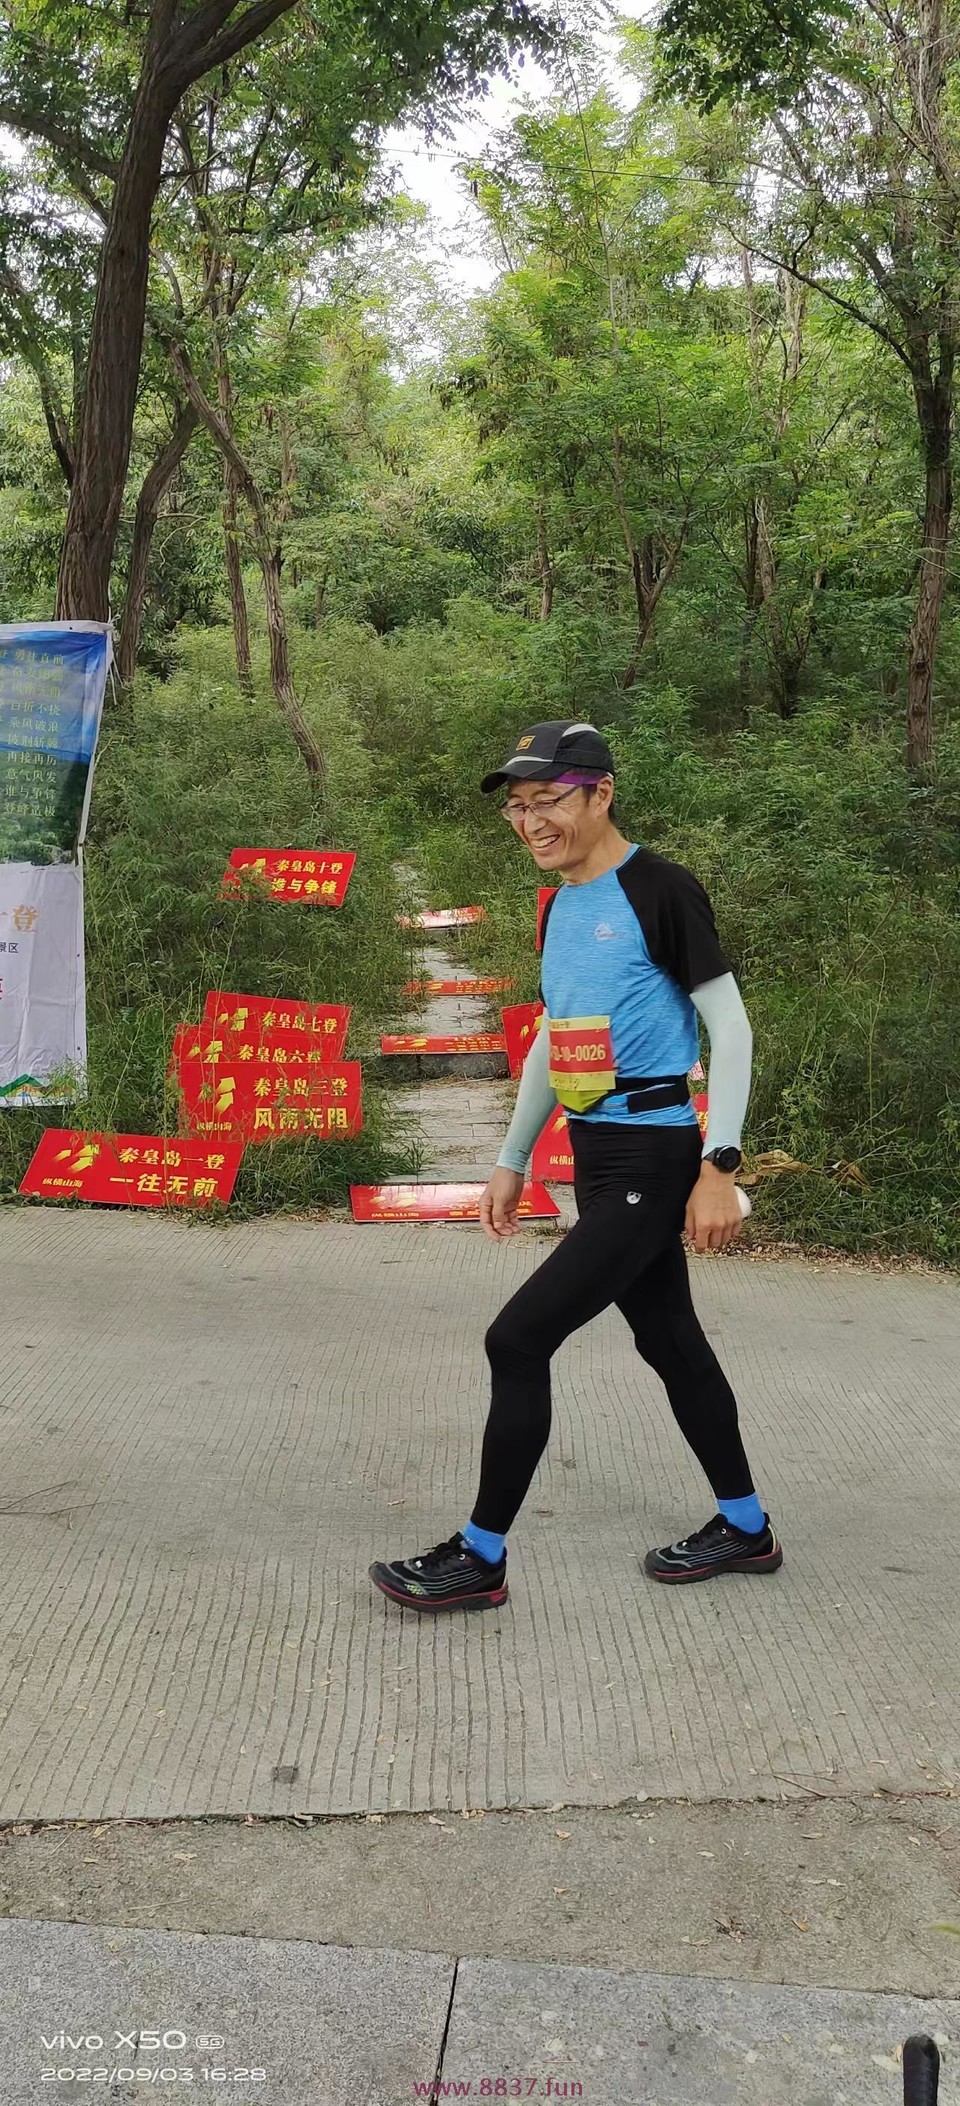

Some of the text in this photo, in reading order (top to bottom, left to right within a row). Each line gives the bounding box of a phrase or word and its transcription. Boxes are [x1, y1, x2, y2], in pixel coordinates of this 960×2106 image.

[9, 717, 59, 731] 乘风破浪
[7, 751, 57, 765] 再接再厉
[5, 768, 57, 783] 意气风发
[5, 785, 57, 800] 谁与争锋
[4, 801, 56, 817] 登峰造极
[277, 859, 343, 874] 秦皇岛十登
[271, 878, 337, 894] 谁与争锋
[262, 1011, 338, 1034] 秦皇岛七登
[253, 1077, 348, 1096] 秦皇岛三登
[253, 1107, 348, 1130] 风雨无阻
[119, 1147, 226, 1171] 秦皇岛一登
[42, 1177, 83, 1187] 纵横山海
[109, 1173, 218, 1198] 一往无前
